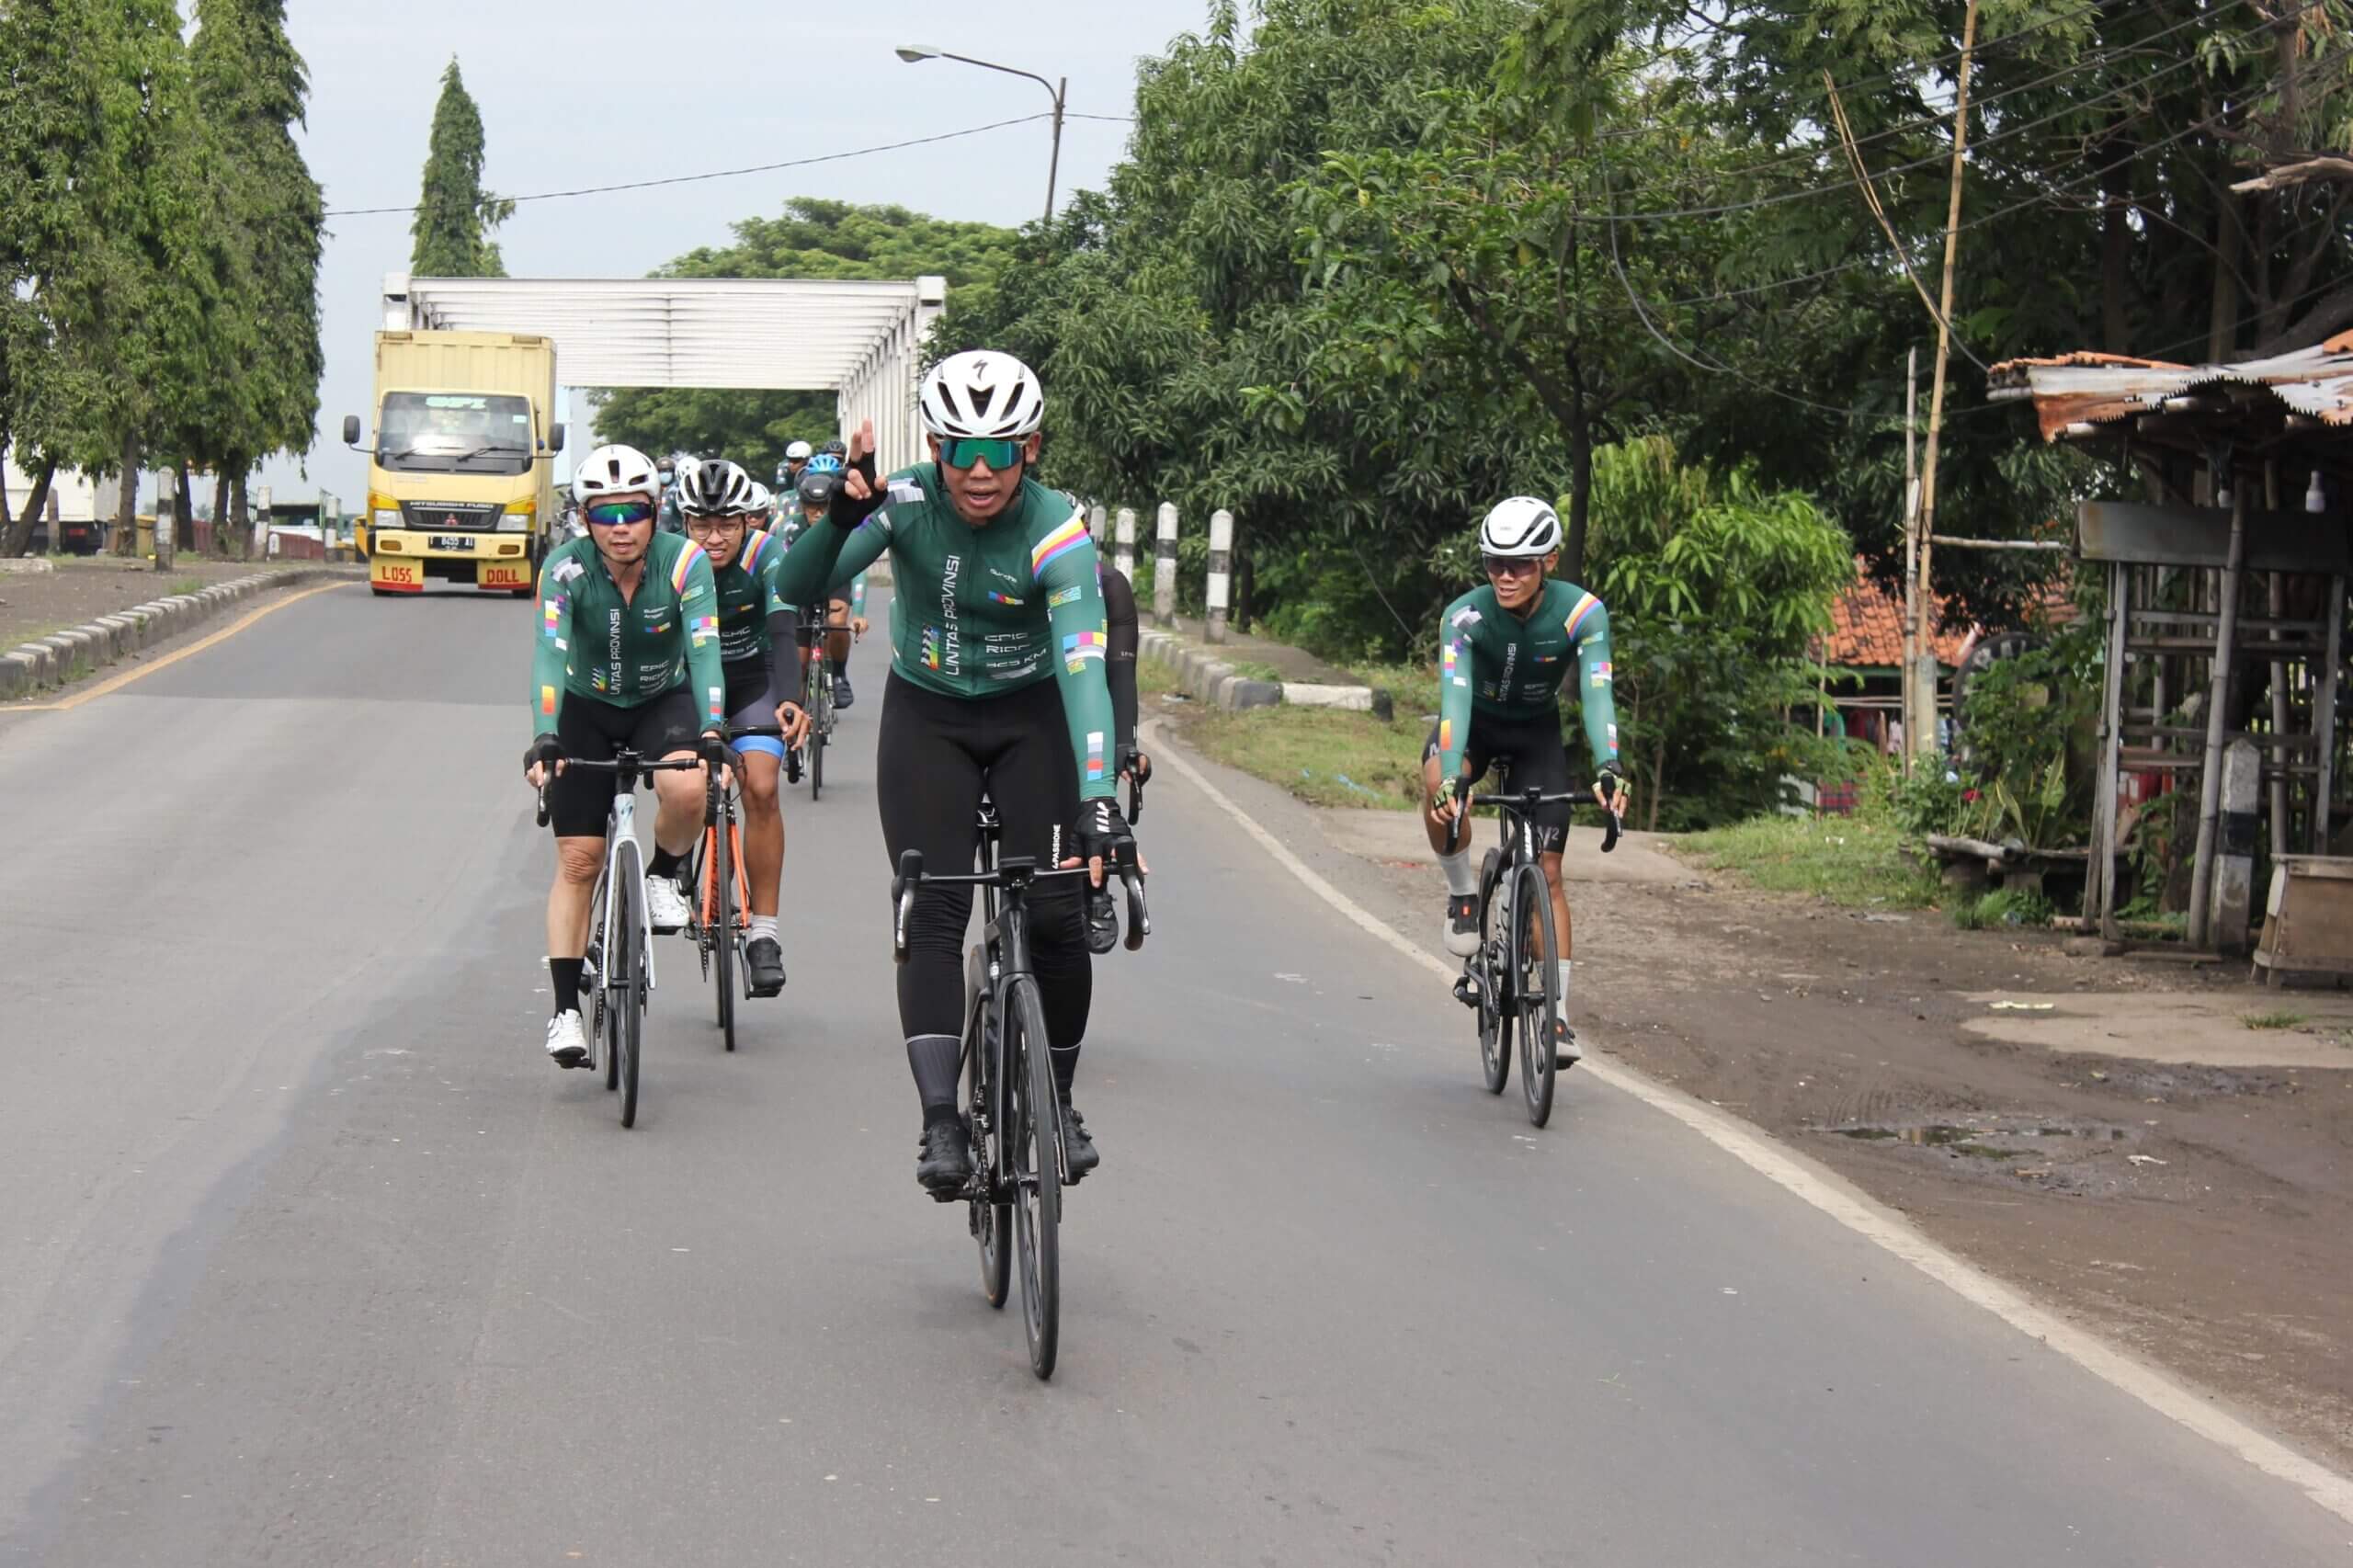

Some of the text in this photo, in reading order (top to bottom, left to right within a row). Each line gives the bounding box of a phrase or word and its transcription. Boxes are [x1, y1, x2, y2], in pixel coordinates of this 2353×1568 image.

[381, 566, 519, 583] LOSS DOLL
[609, 608, 621, 660] PROVINSI
[941, 555, 961, 676] LINTAS PROVINSI
